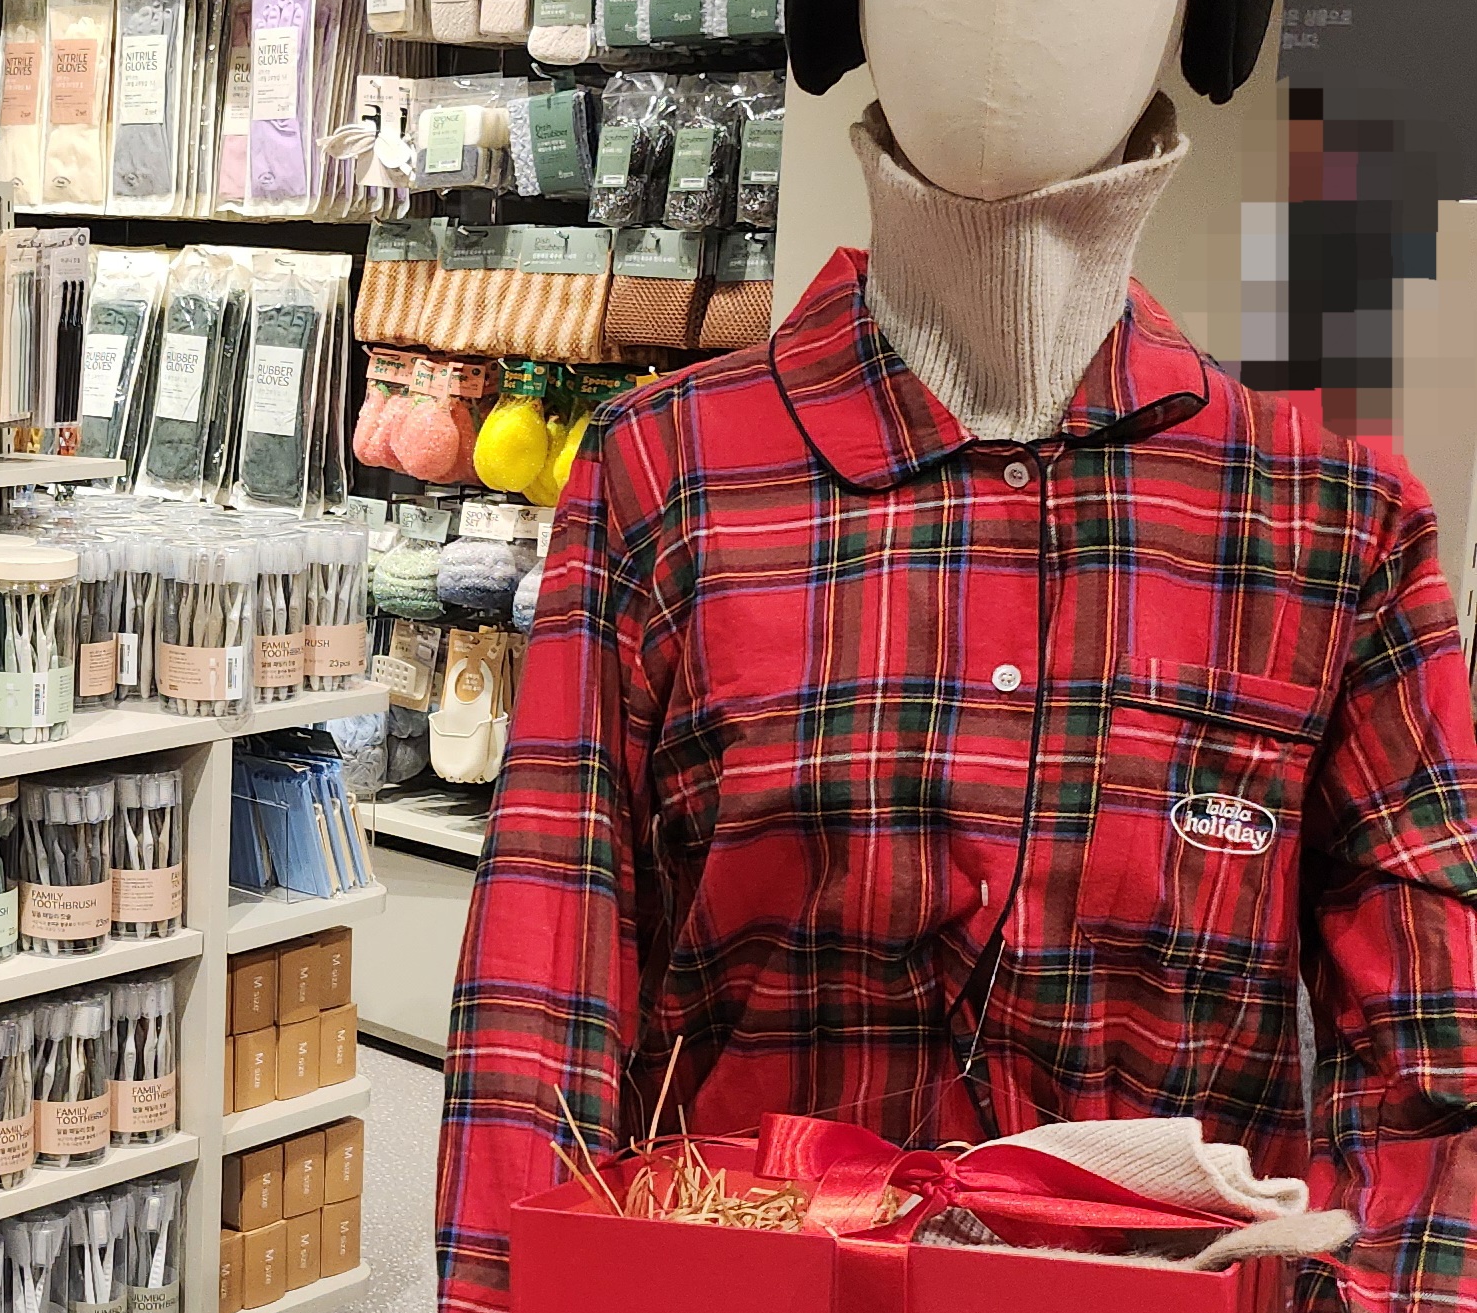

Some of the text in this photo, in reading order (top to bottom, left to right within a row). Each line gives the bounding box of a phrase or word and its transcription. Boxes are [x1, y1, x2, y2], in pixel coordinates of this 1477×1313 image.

[258, 44, 289, 55] NITRILE
[56, 53, 88, 63] NITRILE
[125, 51, 157, 62] NITRILE
[258, 53, 289, 66] GLOVES
[56, 62, 88, 73] GLOVES
[125, 61, 158, 71] GLOVES
[166, 351, 199, 364] RUBBER
[166, 362, 195, 373] GLOVES
[257, 365, 293, 377] RUBBER
[257, 375, 290, 387] GLOVES
[261, 641, 291, 651] FAMILY
[1184, 811, 1268, 850] holiday
[32, 890, 63, 900] FAMILY
[32, 899, 96, 909] TOOTHBRUSH
[254, 976, 263, 988] M
[299, 1042, 307, 1054] M
[255, 1052, 263, 1065] M
[132, 1085, 162, 1095] FAMILY
[56, 1107, 89, 1117] FAMILY
[344, 1147, 353, 1159] M
[265, 1249, 273, 1261] M
[131, 1293, 166, 1304] JUMBO
